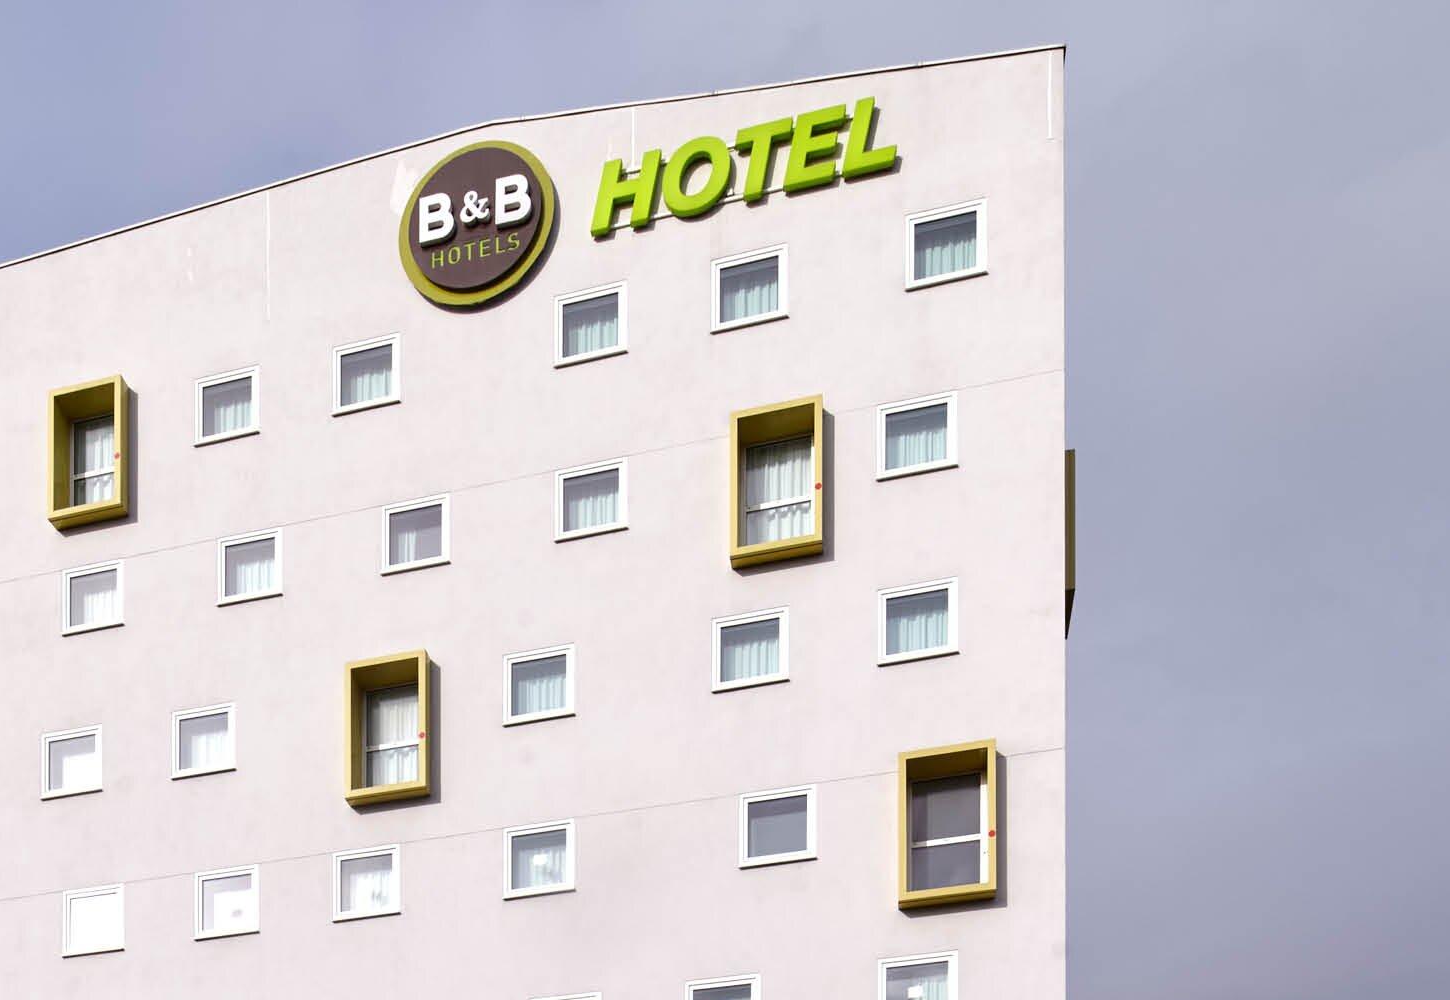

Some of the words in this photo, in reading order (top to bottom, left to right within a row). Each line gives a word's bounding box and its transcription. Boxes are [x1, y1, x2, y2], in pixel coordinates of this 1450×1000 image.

[590, 96, 898, 239] HOTEL
[417, 172, 533, 249] B&B
[430, 231, 522, 269] HOTELS
